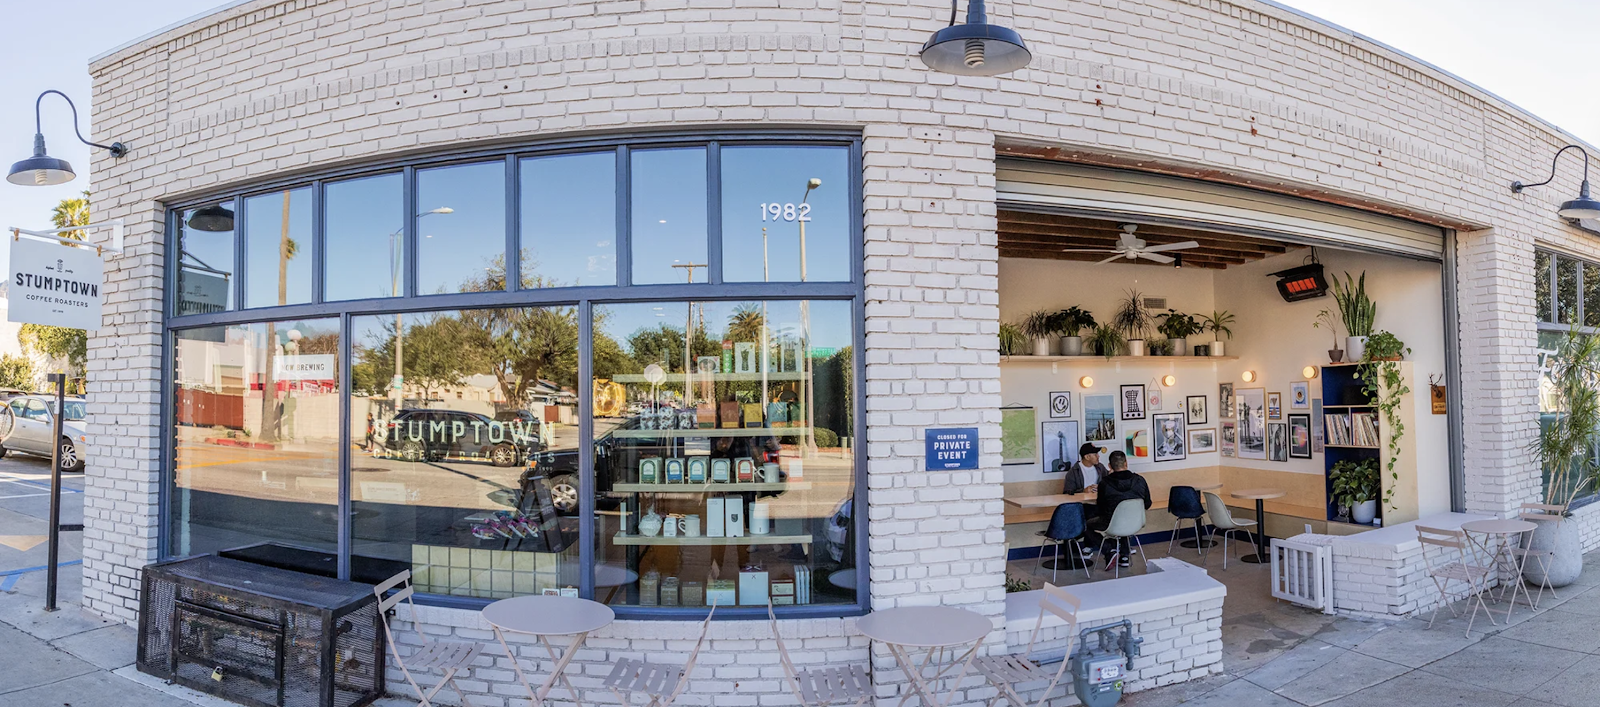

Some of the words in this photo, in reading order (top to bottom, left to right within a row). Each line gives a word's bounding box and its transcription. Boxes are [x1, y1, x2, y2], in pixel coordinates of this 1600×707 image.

[760, 203, 811, 222] 1982
[16, 272, 98, 298] STUMPTOWN
[26, 294, 52, 303] COFFEE
[55, 298, 88, 308] ROASTERS
[296, 363, 325, 371] BREWING
[373, 419, 556, 446] STUMPTOWN
[934, 441, 971, 450] PRIVATE
[459, 450, 556, 463] ROATERS
[938, 451, 967, 460] EVENT
